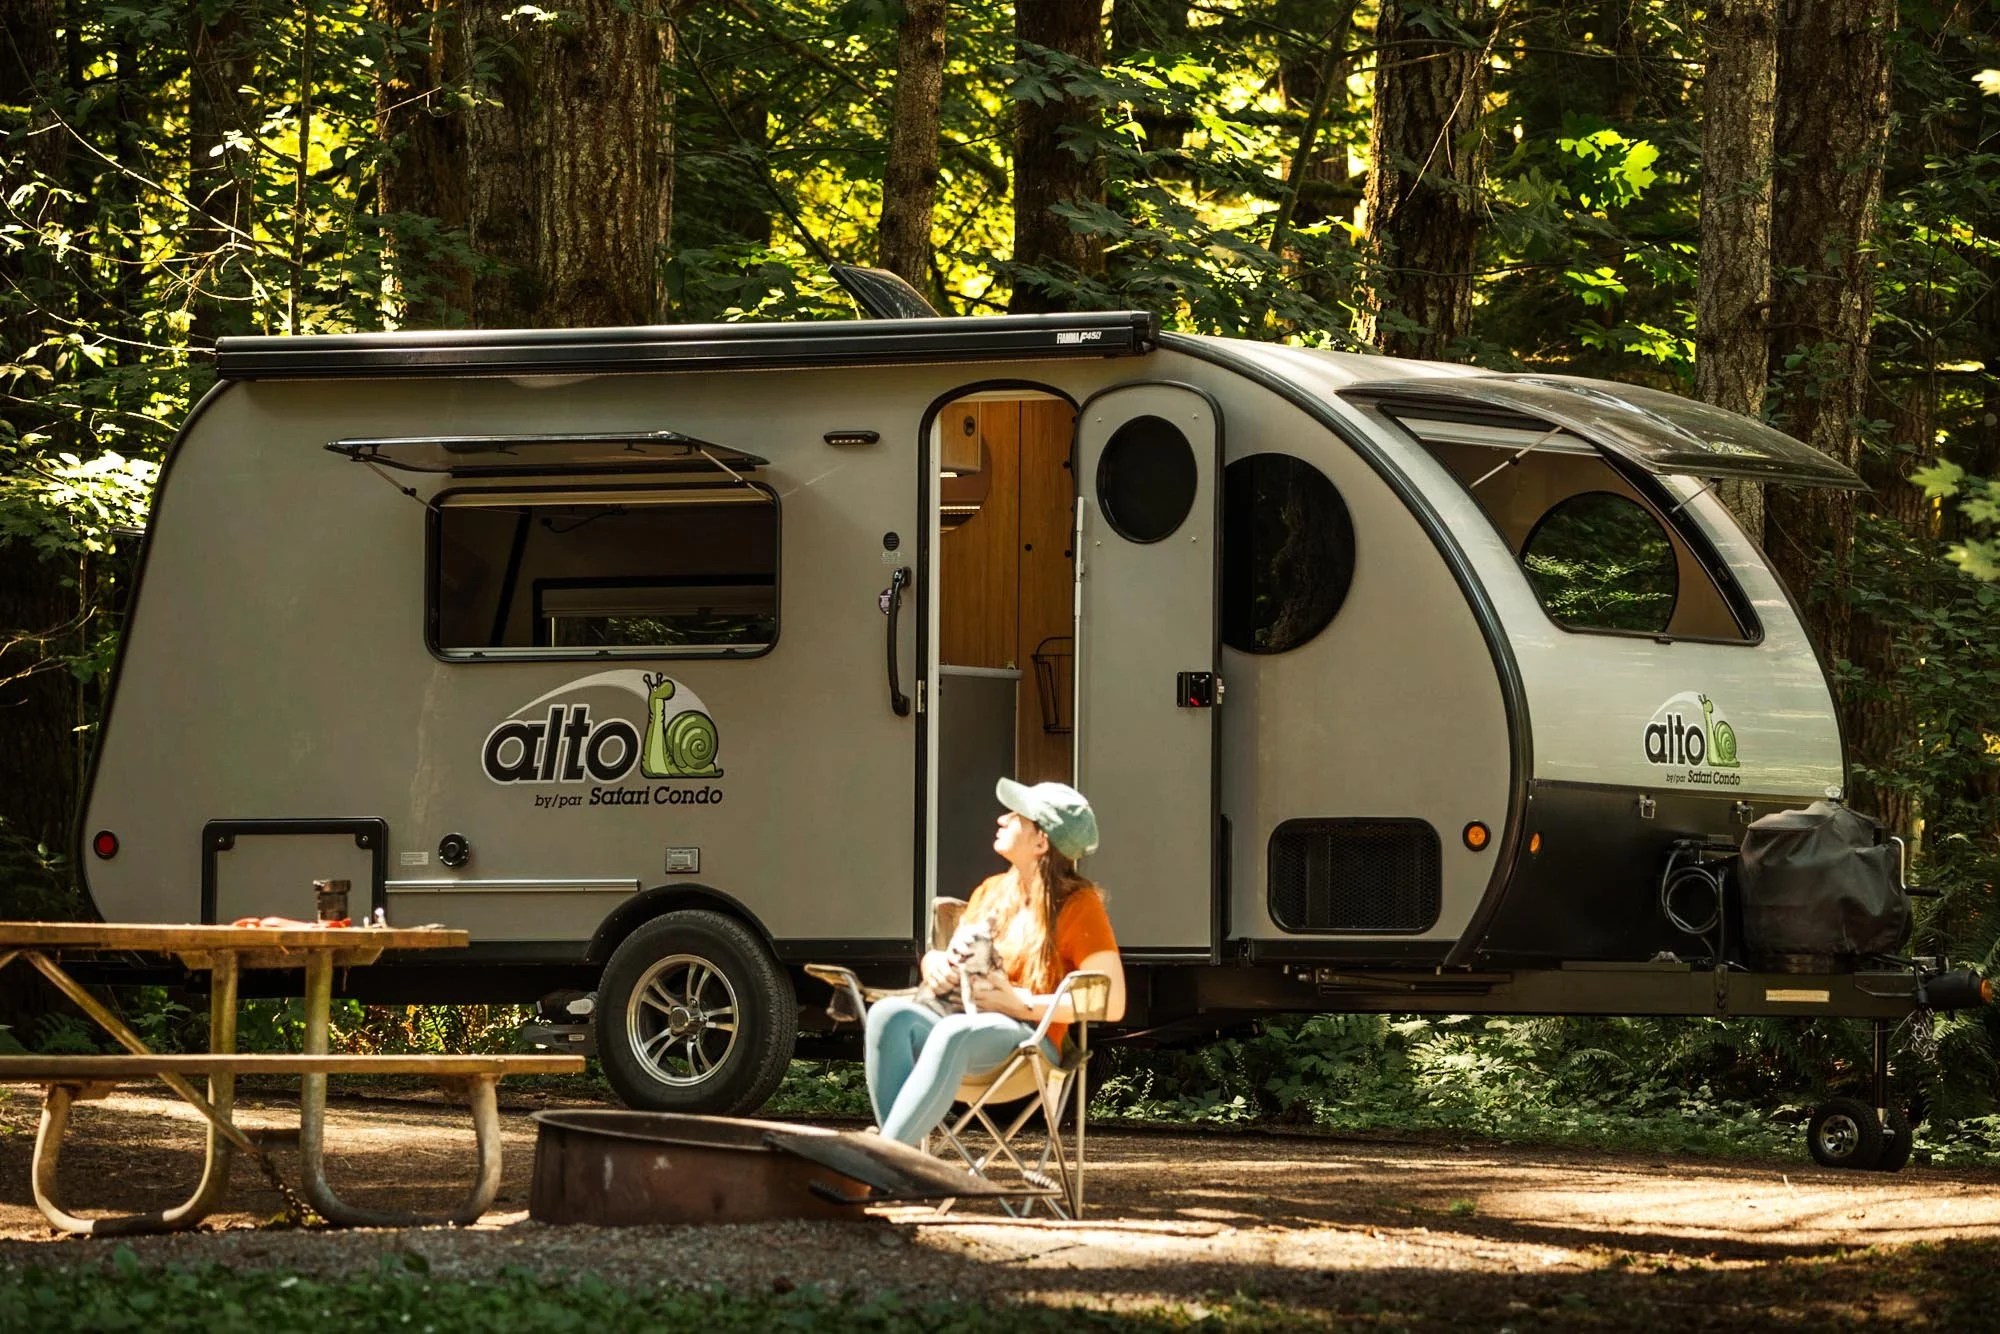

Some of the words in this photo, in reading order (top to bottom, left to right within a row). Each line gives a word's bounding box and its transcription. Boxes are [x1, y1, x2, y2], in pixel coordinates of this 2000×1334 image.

[482, 704, 641, 785] alto
[1644, 713, 1706, 767] alto
[1666, 773, 1686, 784] by/par
[1687, 769, 1712, 784] Safari
[1714, 771, 1741, 785] Condo
[534, 794, 583, 809] by/par
[589, 786, 650, 805] Safari
[653, 786, 723, 805] Condo
